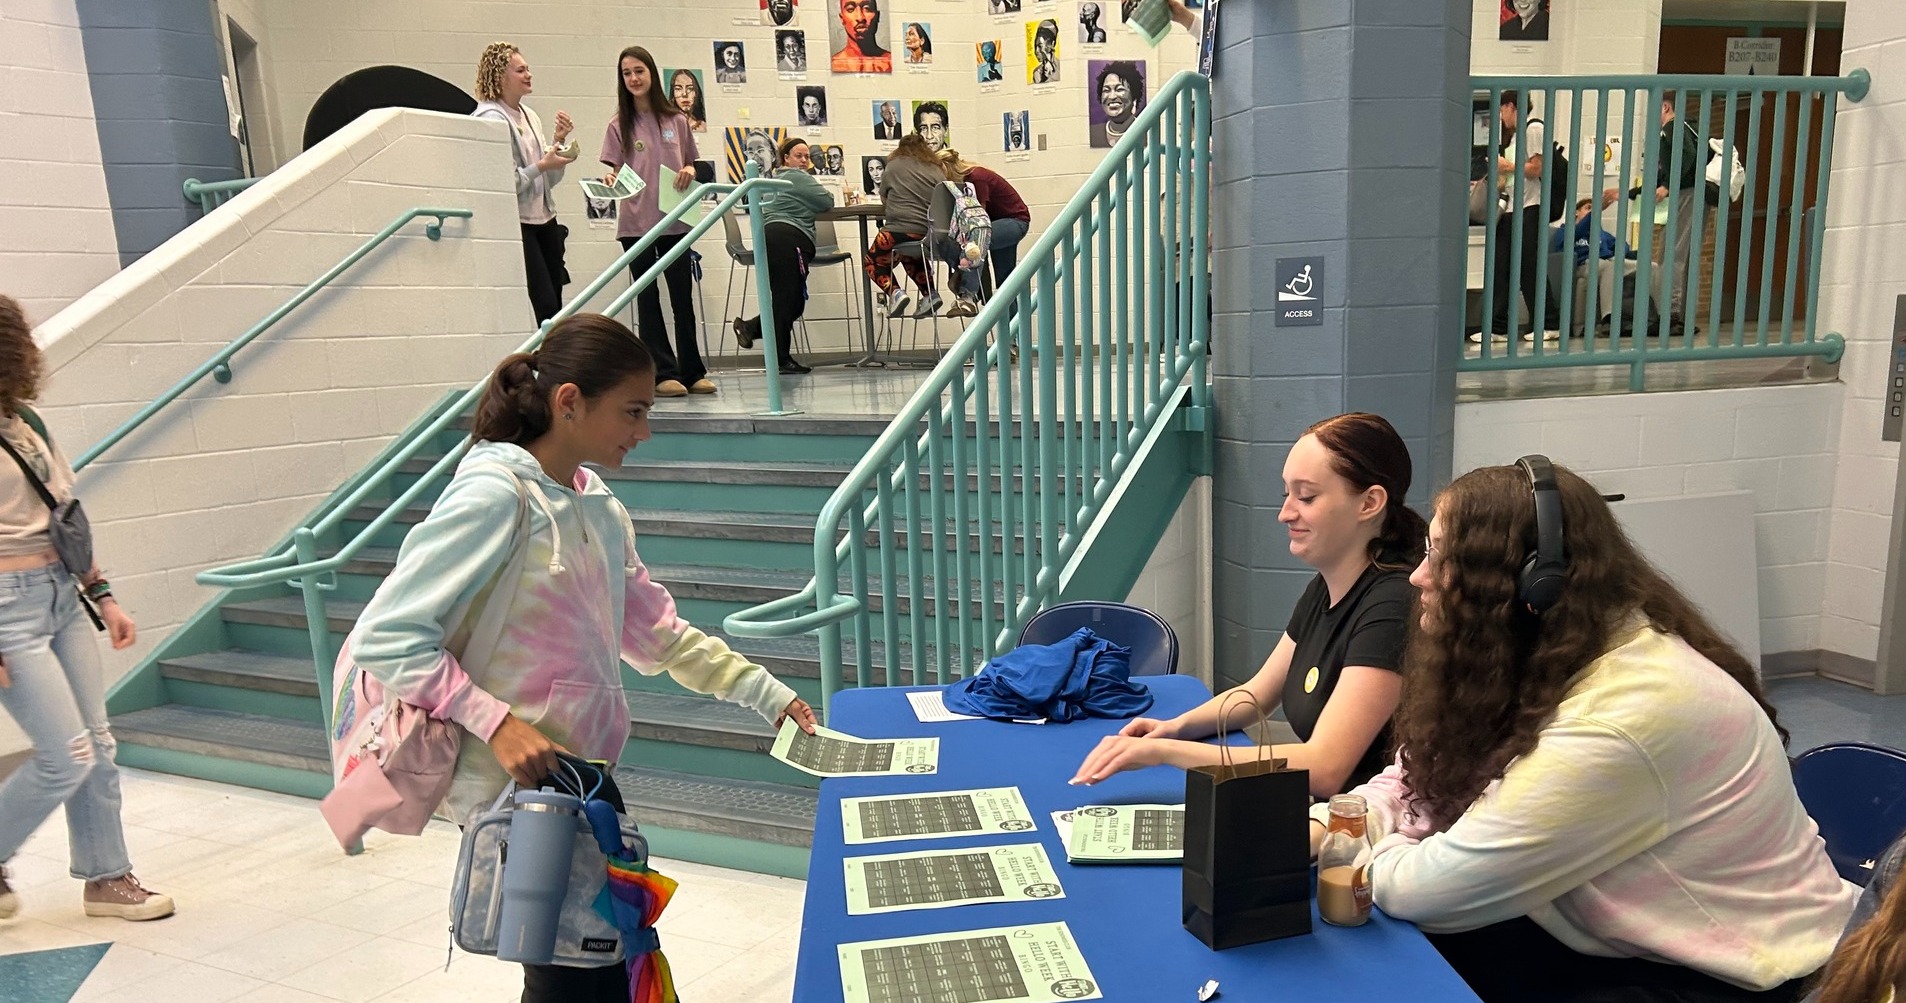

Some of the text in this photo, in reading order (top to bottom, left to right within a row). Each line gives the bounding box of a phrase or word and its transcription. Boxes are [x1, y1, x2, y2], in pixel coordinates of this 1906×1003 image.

[1285, 310, 1313, 318] ACCESS
[1008, 857, 1028, 887] HELLO WEEK
[1022, 856, 1037, 871] START
[1029, 871, 1043, 883] WITH
[1018, 954, 1033, 973] BINGO
[1028, 941, 1055, 981] HELLO WEEK
[1045, 940, 1064, 960] START
[1056, 960, 1073, 979] WITH
